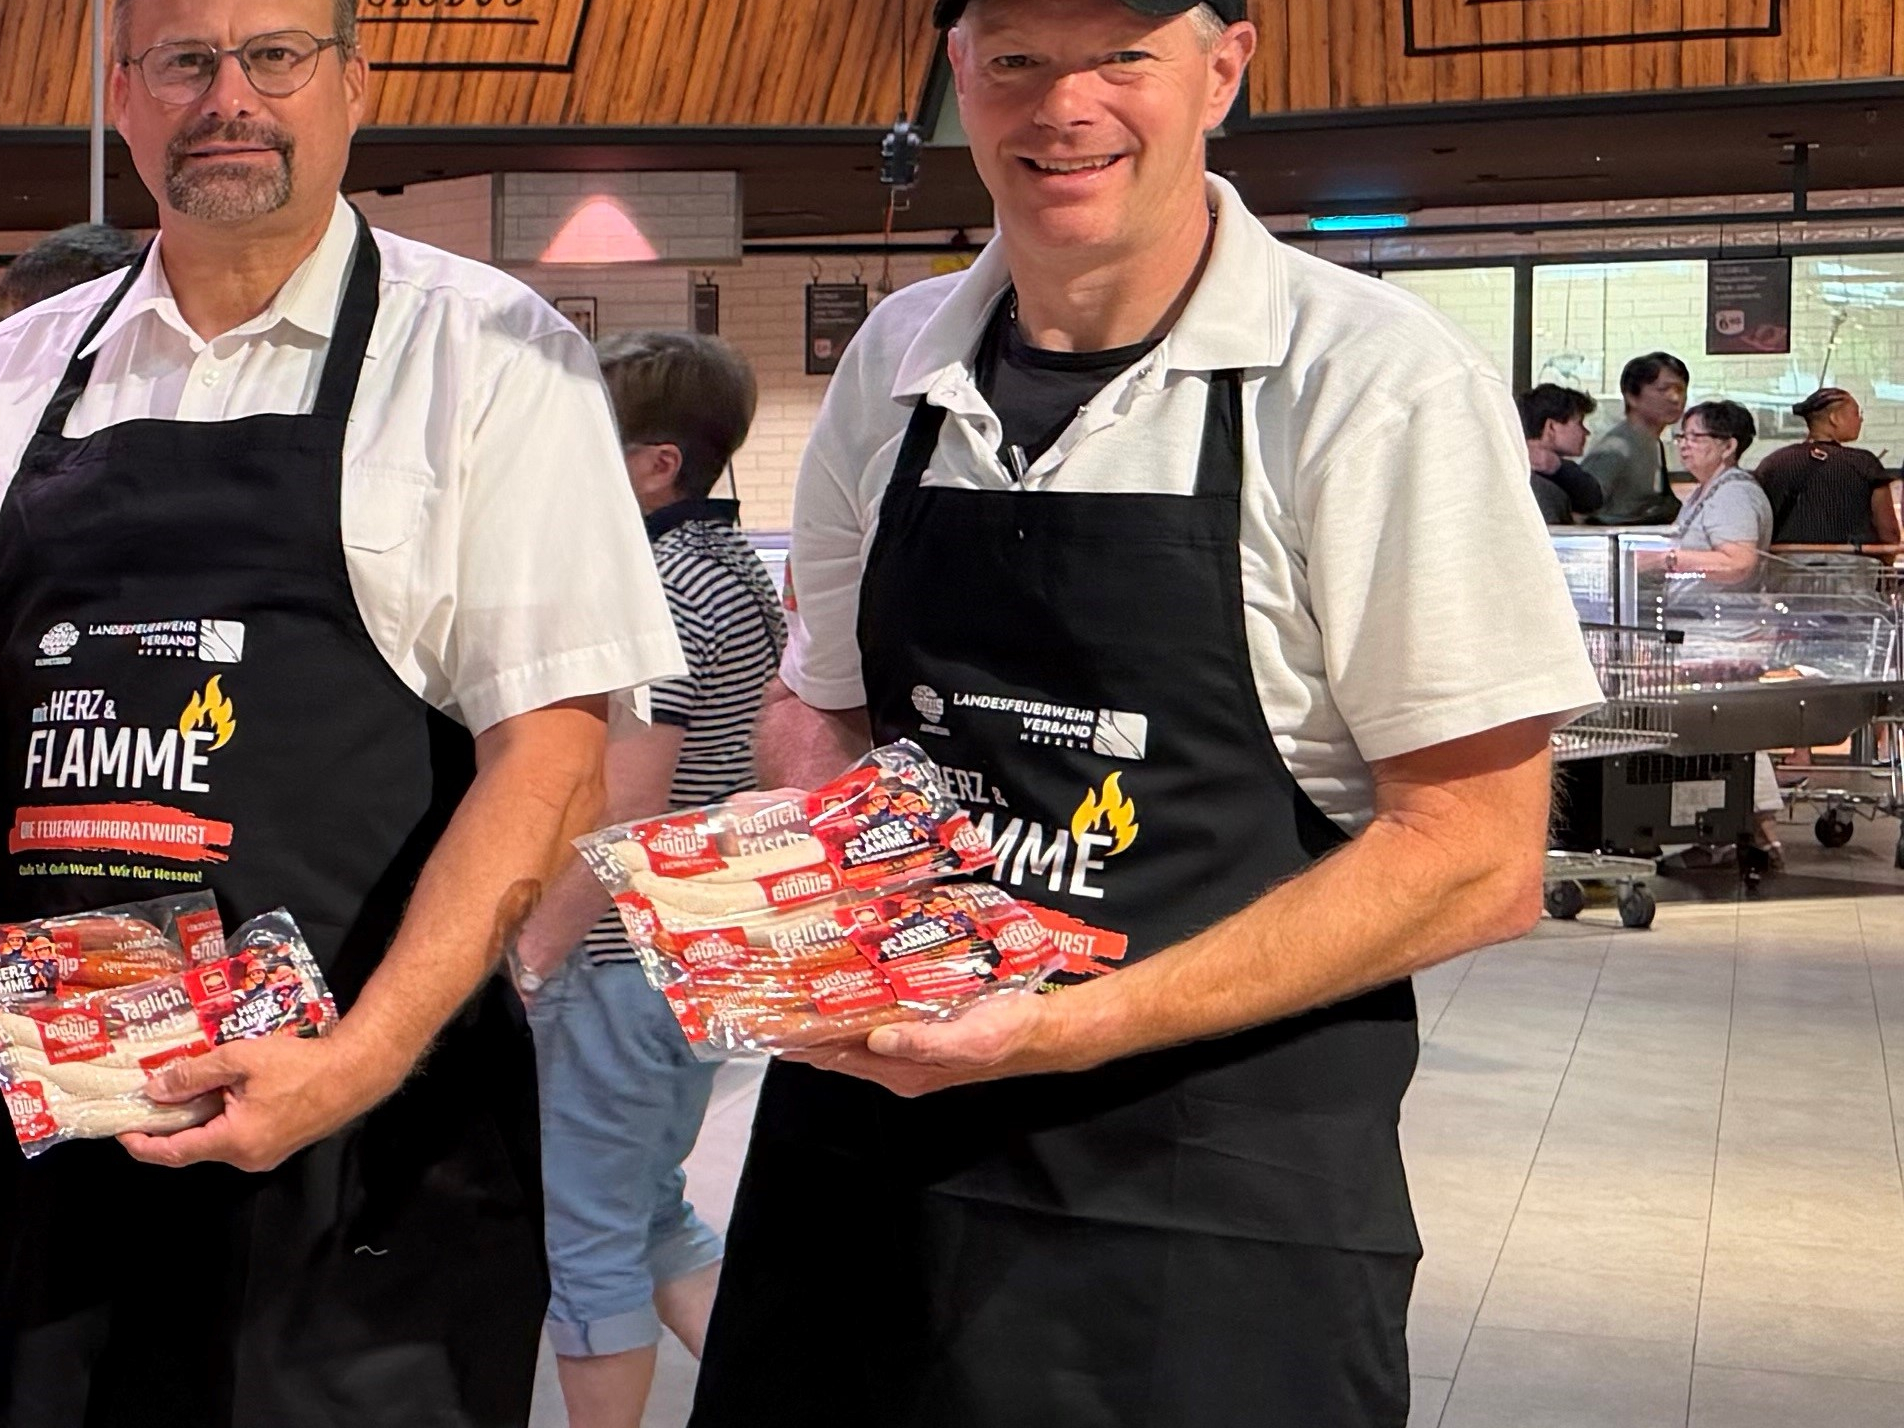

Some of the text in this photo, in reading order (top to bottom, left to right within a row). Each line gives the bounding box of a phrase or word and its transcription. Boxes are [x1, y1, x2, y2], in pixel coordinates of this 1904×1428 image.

[89, 621, 196, 635] LANDESFEUERWEHR
[141, 635, 196, 646] VERBAND
[50, 690, 105, 721] HERZ
[104, 700, 116, 719] &
[954, 693, 1094, 722] LANDESFEUERWEHR
[1023, 717, 1091, 738] VERBAND
[24, 727, 213, 793] FLAMME
[38, 821, 206, 844] FEUERWEHRBRATWURST
[864, 820, 903, 844] HERZ
[846, 830, 911, 860] FLAMME
[109, 865, 130, 877] Wir
[133, 866, 151, 879] für
[154, 867, 203, 883] Hessen!
[238, 996, 277, 1016] HERZ
